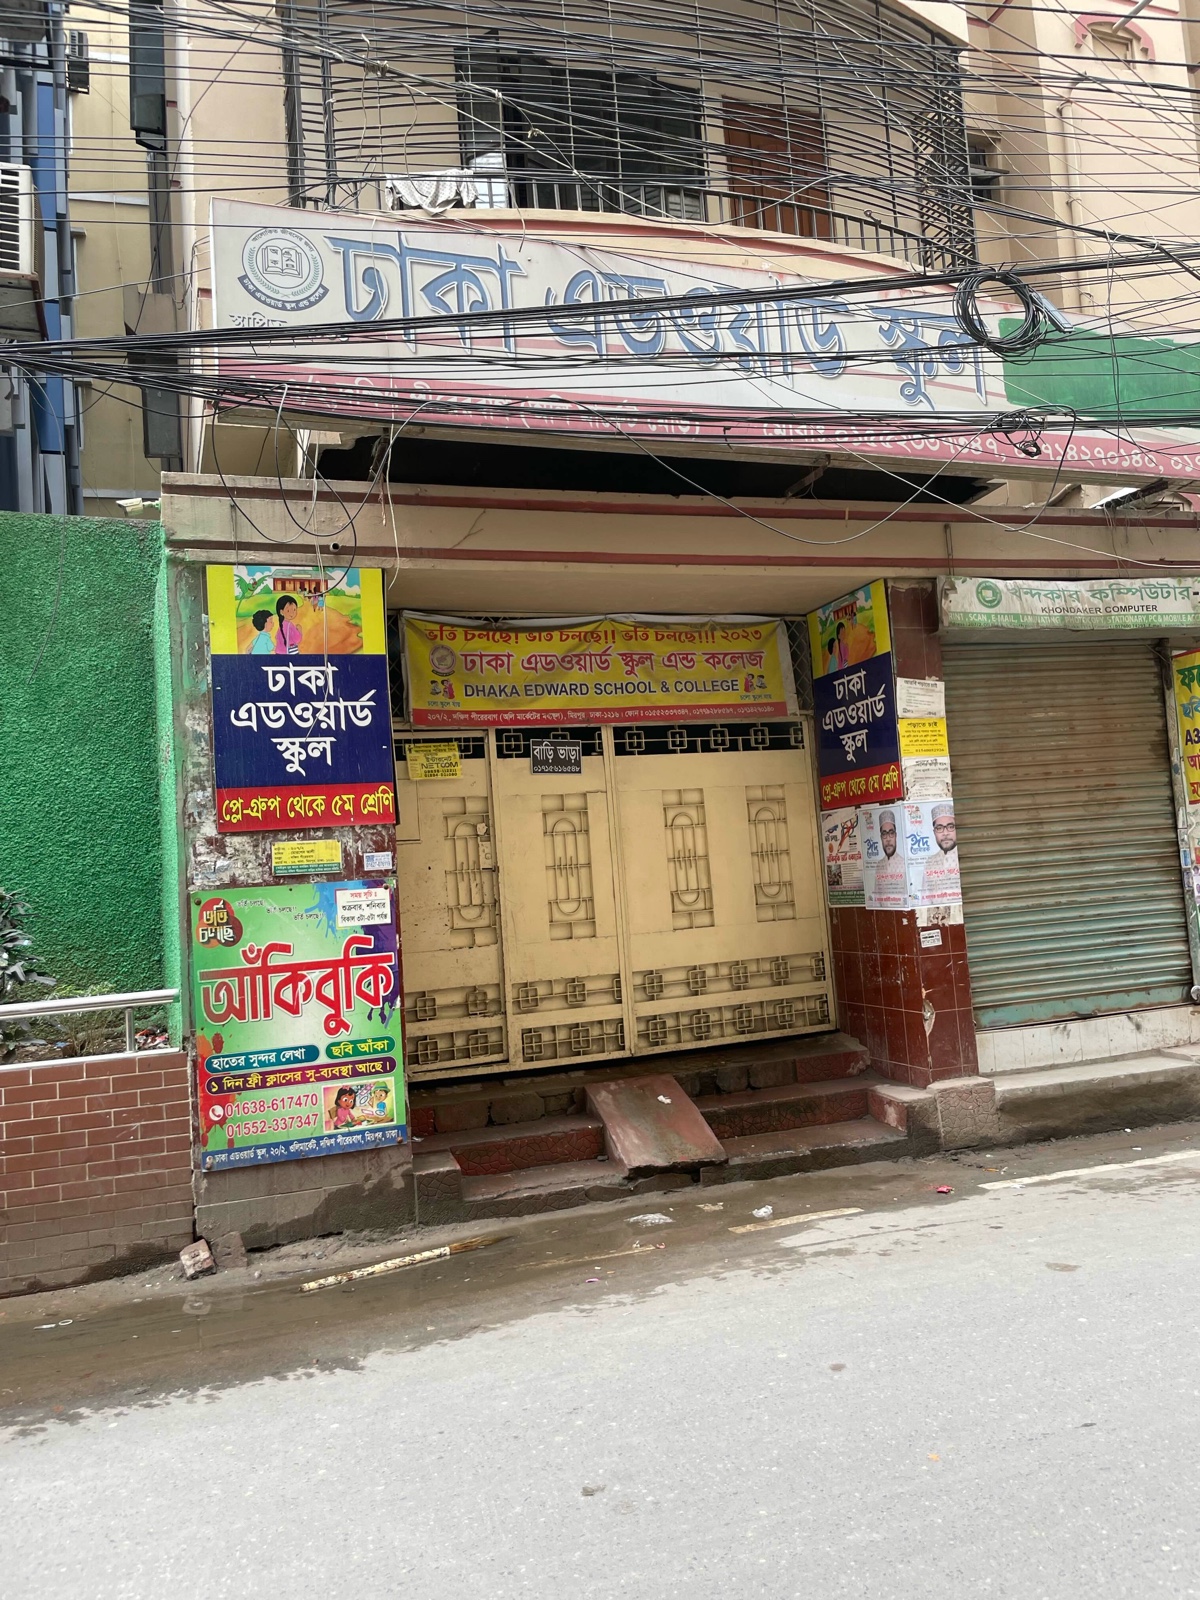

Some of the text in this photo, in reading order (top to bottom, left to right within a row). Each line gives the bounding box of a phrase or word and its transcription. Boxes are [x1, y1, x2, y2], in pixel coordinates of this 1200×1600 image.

[323, 231, 528, 359] ঢাকা
[868, 302, 989, 411] স্কুল
[1014, 442, 1164, 474] ০৭১৪২৭০১৪০,
[1006, 582, 1082, 603] খন্দকার
[1041, 604, 1158, 615] KHONDAKER COMPUTER
[1148, 614, 1157, 622] PC
[1157, 615, 1163, 623] &
[1163, 614, 1187, 622] MOBILE
[721, 628, 763, 643] ২০২৩
[460, 651, 514, 675] ঢাকা
[521, 645, 613, 675] এডওয়ার্ড
[617, 650, 655, 679] স্কুল
[662, 651, 697, 671] এন্ড
[701, 650, 766, 670] কলেজ
[261, 662, 339, 697] ঢাকা
[464, 679, 740, 698] DHAKA EDWARD SCHOOL & COLLEGE
[833, 668, 867, 701] ঢাকা
[230, 689, 377, 732] এডওয়ার্ড
[822, 683, 887, 733] এডওয়ার্ড
[270, 736, 337, 777] স্কুল
[533, 741, 581, 763] বাড়ি ভাড়া
[839, 729, 869, 764] স্কুল
[848, 777, 866, 797] থেকে
[868, 775, 880, 793] ৫ম
[882, 764, 900, 791] শ্রেণি
[223, 785, 395, 823] প্লে-গ্রুপ থেকে ৫ম শ্রেণি
[863, 836, 879, 852] ঈদ
[905, 831, 930, 848] ঈদ
[341, 900, 386, 912] শুক্রবার, শনিবার
[363, 890, 373, 899] সূচি
[203, 899, 230, 928] ভর্তি
[340, 914, 356, 924] বিকাল
[198, 924, 235, 945] চলছে
[199, 935, 394, 1036] আঁকিবুকি
[211, 1047, 306, 1071] হাতের সুন্দর লেখা
[330, 1036, 390, 1058] ছবি আঁকা
[211, 1081, 219, 1092] ১
[222, 1076, 243, 1091] দিন
[246, 1072, 262, 1090] ফ্রী
[265, 1070, 302, 1088] ক্লাসের
[305, 1063, 353, 1083] সু-ব্যবস্থা
[224, 1093, 319, 1118] 01638-617470
[226, 1112, 320, 1139] 01552-337347
[214, 1153, 229, 1163] ঢাকা
[229, 1146, 256, 1161] এডওয়ার্ড
[319, 1136, 336, 1149] দক্ষিণ
[336, 1134, 364, 1146] পীরেরবাগ,
[365, 1131, 385, 1143] মিরপুর,
